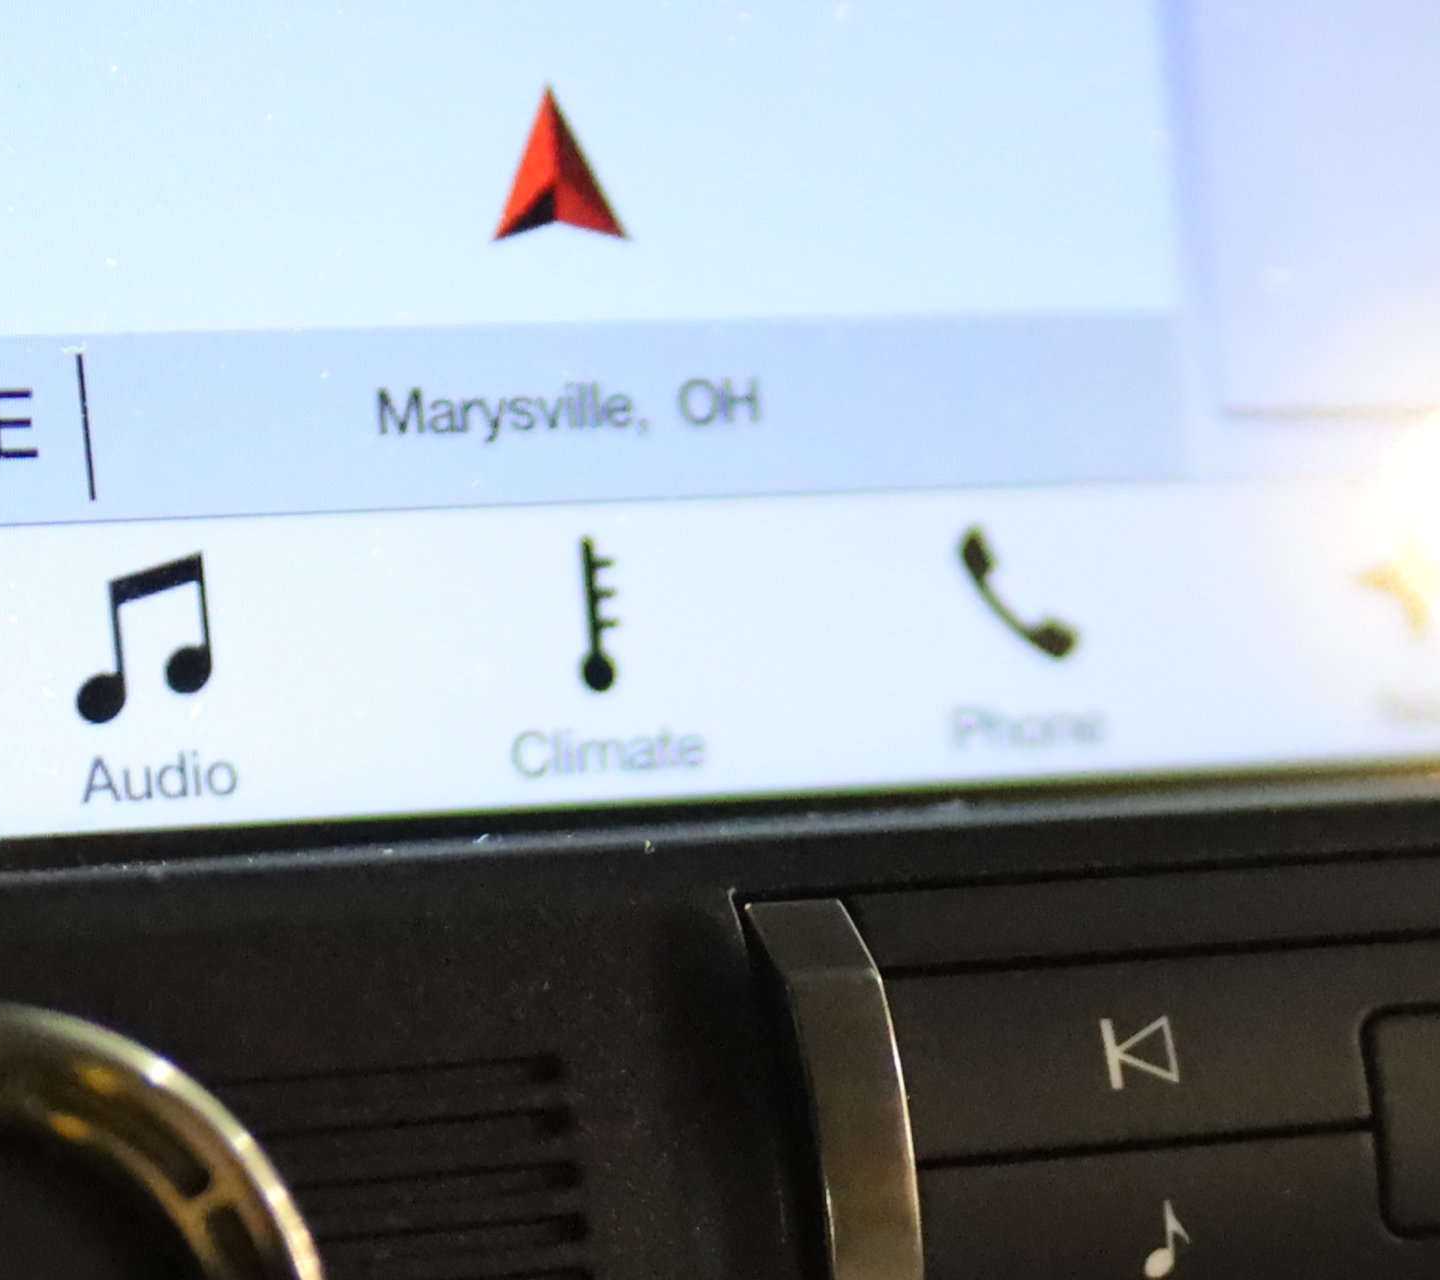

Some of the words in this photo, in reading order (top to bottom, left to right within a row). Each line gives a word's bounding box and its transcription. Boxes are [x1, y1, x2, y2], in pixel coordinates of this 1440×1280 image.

[376, 382, 649, 443] Marysville,
[677, 376, 764, 426] OH
[81, 749, 238, 804] Audio
[511, 727, 707, 779] Climate
